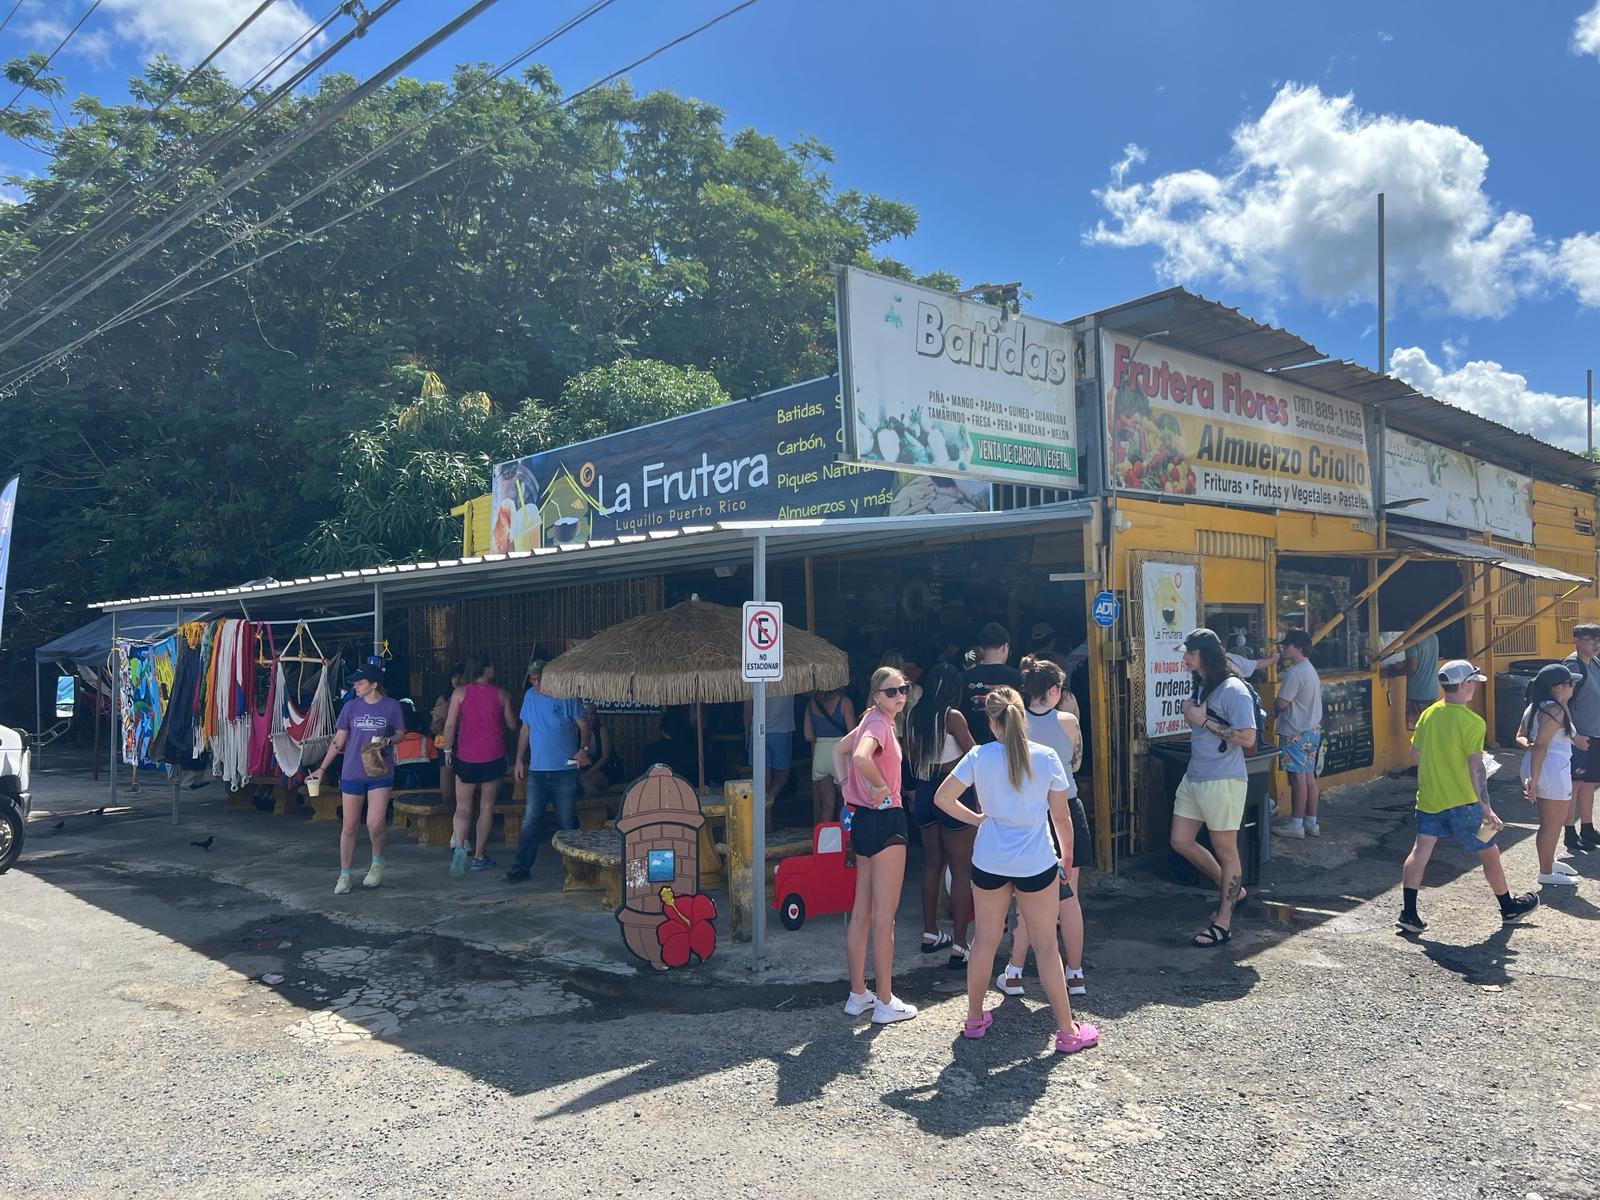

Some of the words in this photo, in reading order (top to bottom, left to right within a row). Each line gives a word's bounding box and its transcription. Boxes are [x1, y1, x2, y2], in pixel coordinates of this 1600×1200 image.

[916, 300, 1066, 385] Batidas
[1113, 343, 1214, 410] Frutera
[1222, 371, 1289, 427] Flores
[777, 402, 825, 424] Batidas,
[929, 390, 945, 404] PIÑA
[951, 395, 974, 409] MANGO
[980, 400, 1003, 414] PAPAYA
[1008, 405, 1030, 419] GUINEO
[1315, 401, 1362, 428] 889-1155
[928, 407, 966, 424] TAMARINDO
[971, 414, 992, 428] FRESA
[997, 419, 1013, 431] PERA
[1018, 422, 1046, 436] MANZANA
[1296, 415, 1326, 433] Servicio
[1326, 423, 1335, 435] de
[1336, 426, 1363, 445] Catering
[776, 433, 826, 456] Carbón,
[978, 439, 1001, 462] VENTA
[1003, 443, 1013, 463] DE
[1014, 442, 1042, 467] CARBÓN
[1043, 449, 1072, 471] VEGETAL
[1196, 424, 1302, 475] Almuerzo
[1308, 445, 1365, 486] Criollo
[598, 475, 631, 516] La
[643, 452, 769, 508] Frutera
[777, 471, 818, 493] Piques
[1203, 472, 1242, 494] Frituras
[1252, 479, 1282, 498] Frutas
[1284, 487, 1289, 502] y
[1291, 484, 1331, 505] Vegetales
[1338, 491, 1368, 509] Pasteles
[616, 511, 663, 534] Luquillo
[669, 505, 712, 523] Puerto
[719, 500, 747, 513] Rico
[778, 500, 846, 520] Almuerzos
[850, 498, 859, 514] y
[1095, 602, 1116, 615] ADT
[747, 662, 779, 670] ESTACIONAR
[1162, 701, 1172, 716] TO
